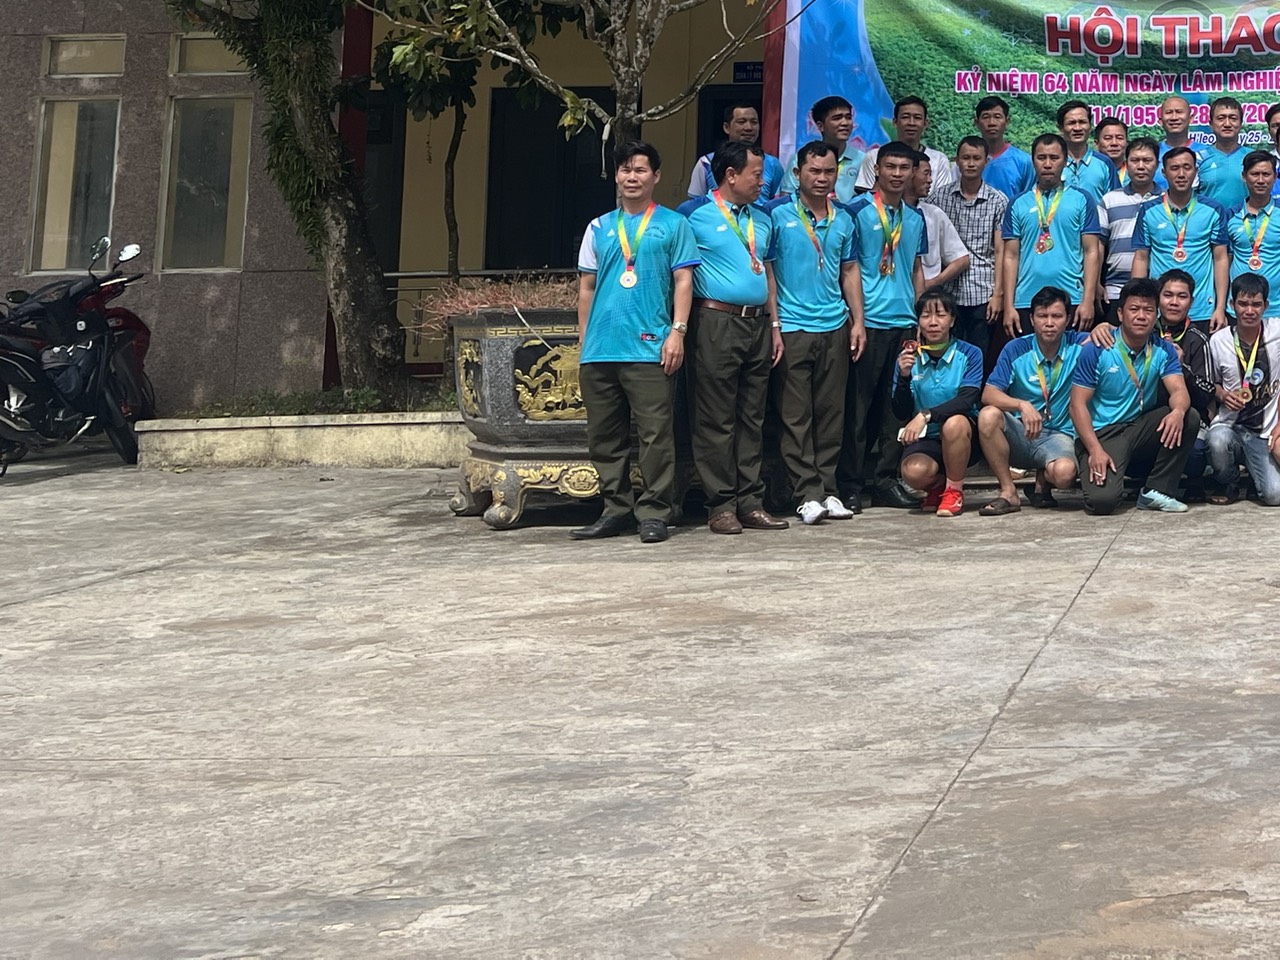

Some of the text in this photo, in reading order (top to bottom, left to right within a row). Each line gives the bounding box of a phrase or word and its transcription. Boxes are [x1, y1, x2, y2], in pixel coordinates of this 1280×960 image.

[1045, 6, 1139, 65] HỘI
[956, 66, 982, 92] KỶ
[988, 69, 1039, 96] NIỆM
[1043, 73, 1068, 94] 64
[1074, 70, 1118, 93] NĂM
[1125, 70, 1177, 93] NGÀY
[1182, 70, 1223, 91] LÂM
[1247, 131, 1260, 143] 25
